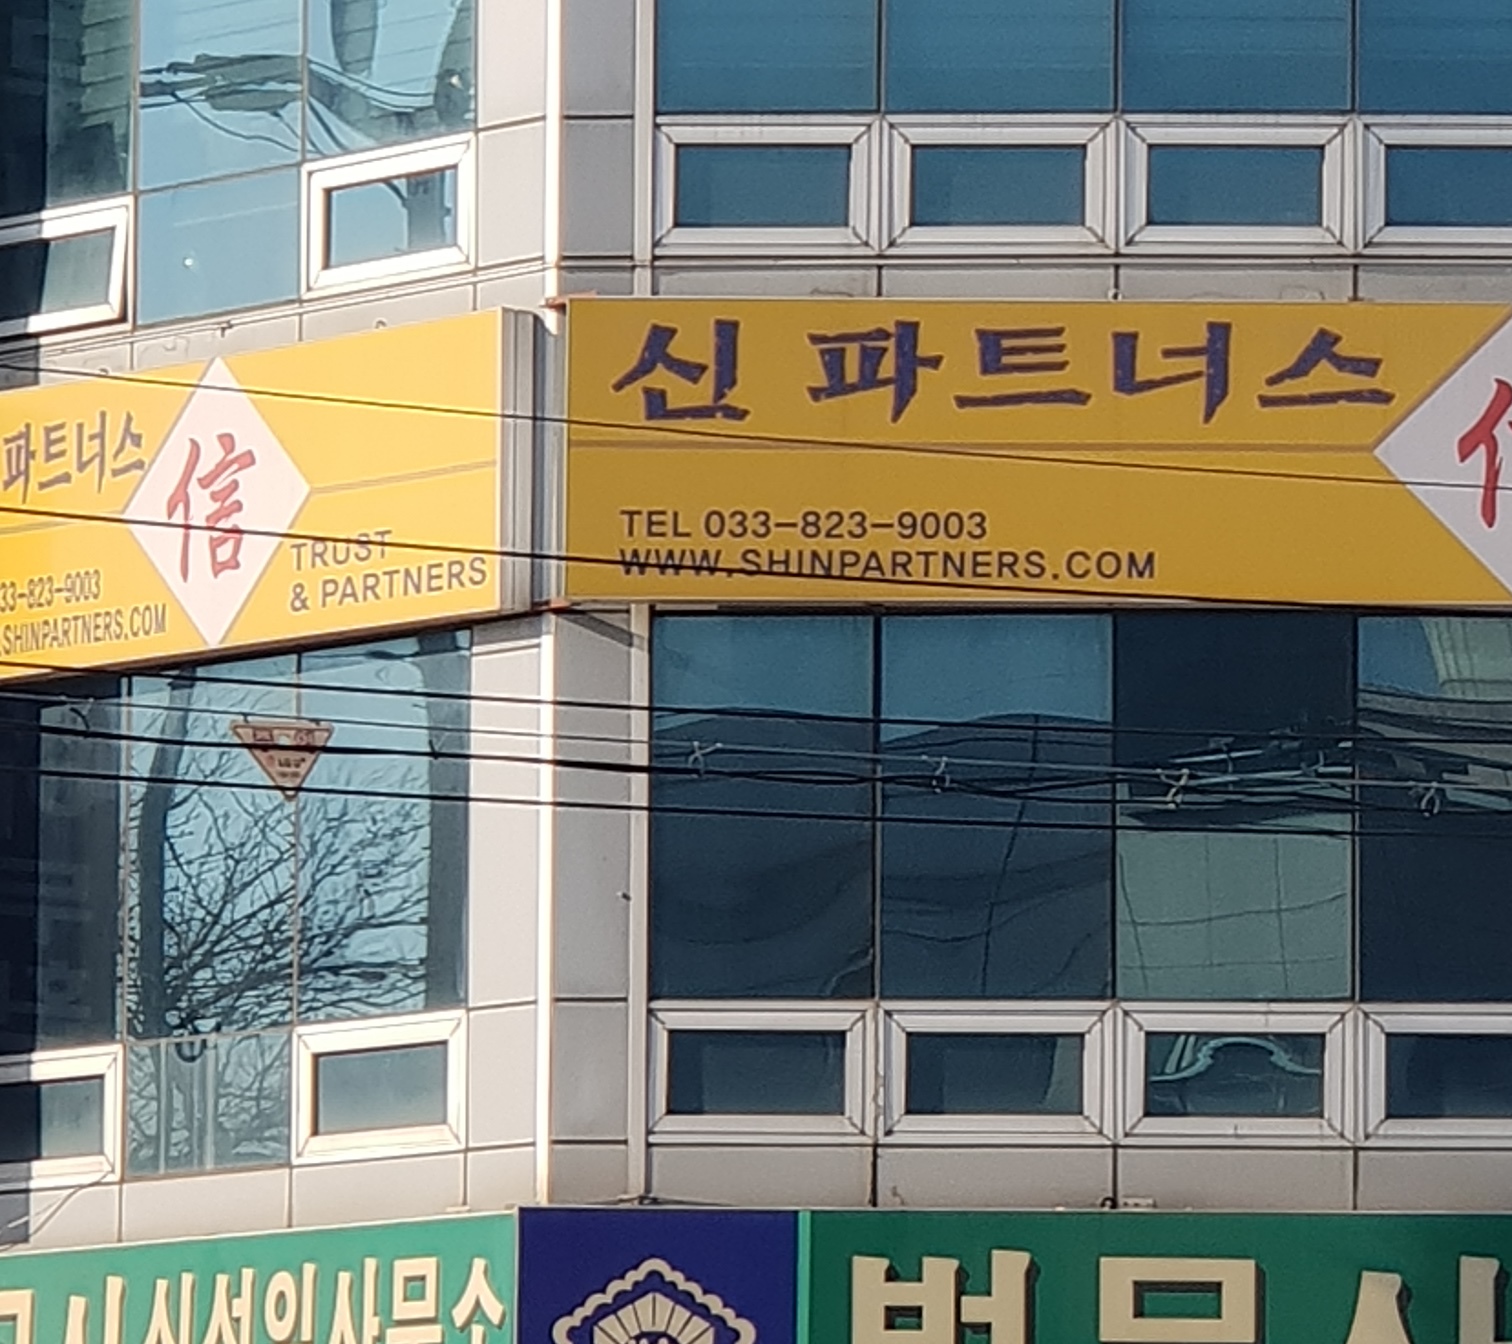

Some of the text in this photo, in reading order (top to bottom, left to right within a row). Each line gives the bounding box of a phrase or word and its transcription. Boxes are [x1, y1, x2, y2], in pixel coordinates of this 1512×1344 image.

[1, 410, 146, 505] 파트너스
[167, 432, 256, 583] 信
[620, 509, 988, 541] TEL 033-823-9003
[291, 529, 393, 573] TRUST
[620, 549, 1157, 581] WWW.SHINPARTNERS.COM
[290, 556, 488, 613] & PARTNERS
